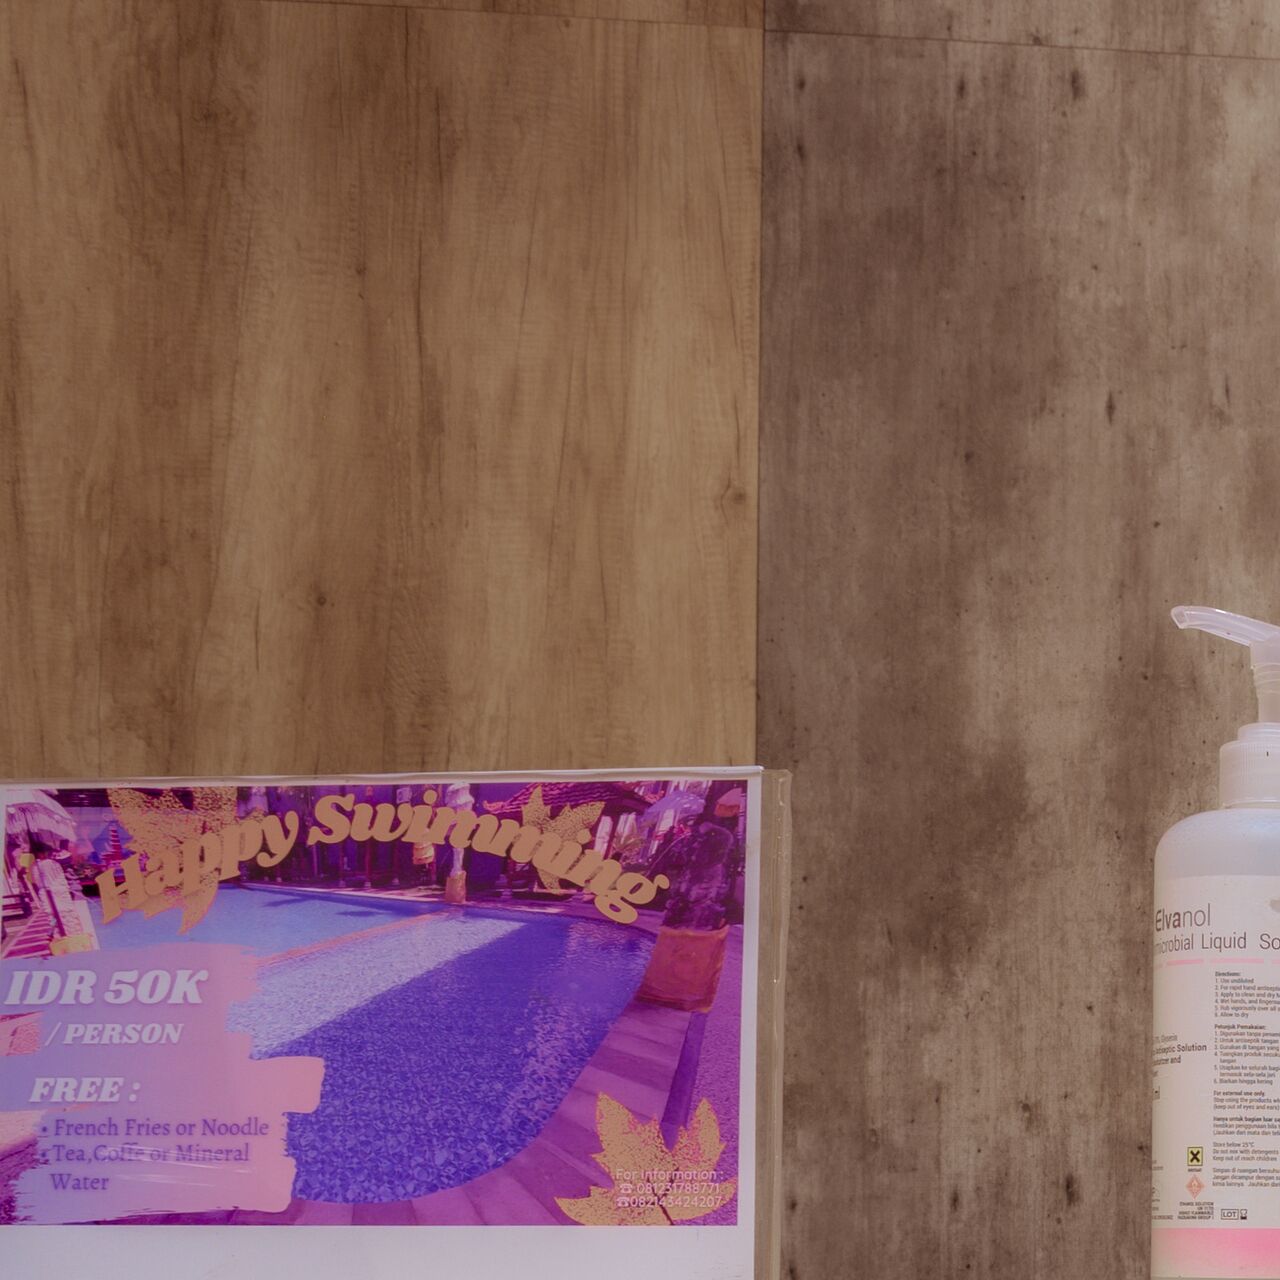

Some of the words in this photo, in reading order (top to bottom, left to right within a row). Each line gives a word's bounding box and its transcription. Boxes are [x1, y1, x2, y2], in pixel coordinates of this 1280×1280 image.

[94, 809, 298, 925] Happy
[306, 789, 670, 924] Swimming
[1202, 932, 1247, 953] Liquid
[5, 970, 97, 1005] IDR
[104, 969, 209, 1005] 50K
[63, 1023, 184, 1045] PERSON
[1177, 1043, 1207, 1053] Solution
[28, 1077, 124, 1103] FREE
[54, 1119, 118, 1136] French
[124, 1119, 170, 1136] Fries
[176, 1123, 196, 1136] or
[201, 1118, 269, 1136] Noodle
[175, 1143, 249, 1162] Mineral
[50, 1173, 109, 1190] Water
[616, 1169, 636, 1179] For
